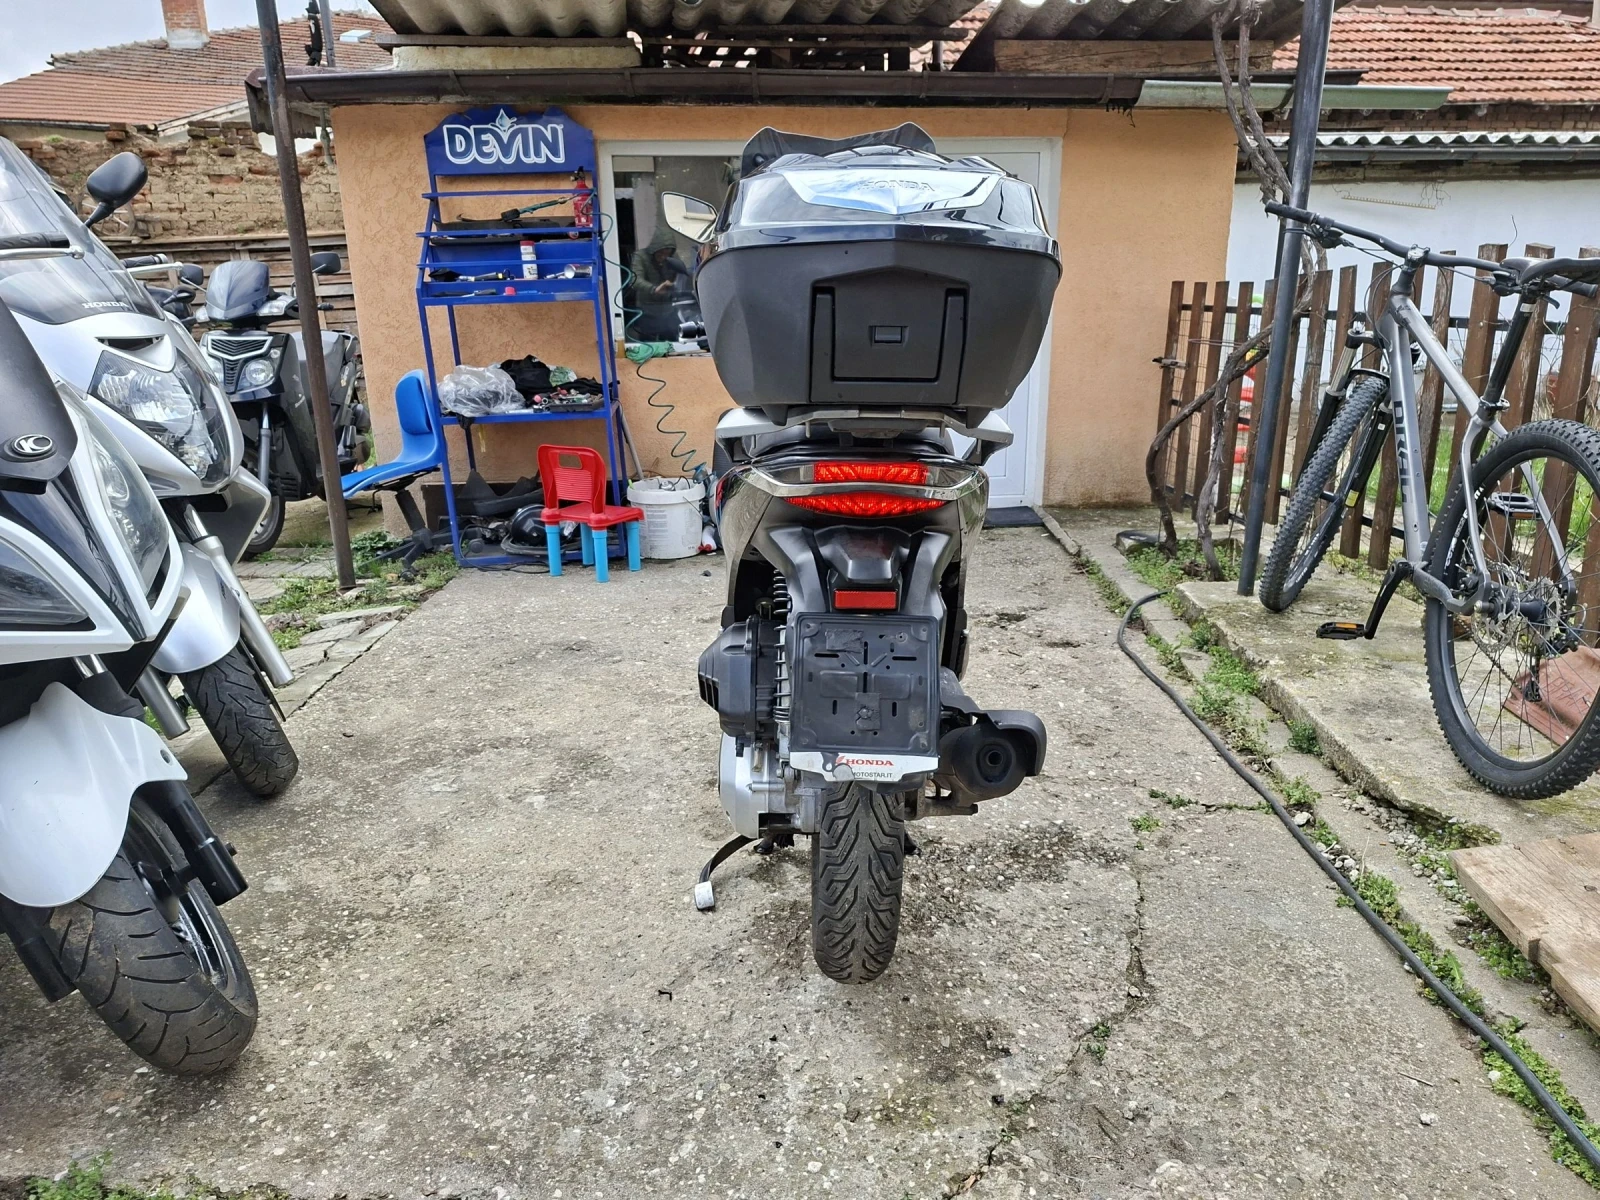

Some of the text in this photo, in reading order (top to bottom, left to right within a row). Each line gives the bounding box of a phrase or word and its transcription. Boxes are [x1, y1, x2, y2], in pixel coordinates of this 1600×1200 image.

[443, 124, 565, 164] DEVIN
[857, 179, 936, 191] HONDA
[82, 301, 129, 309] HONDA
[846, 759, 894, 767] HONDA
